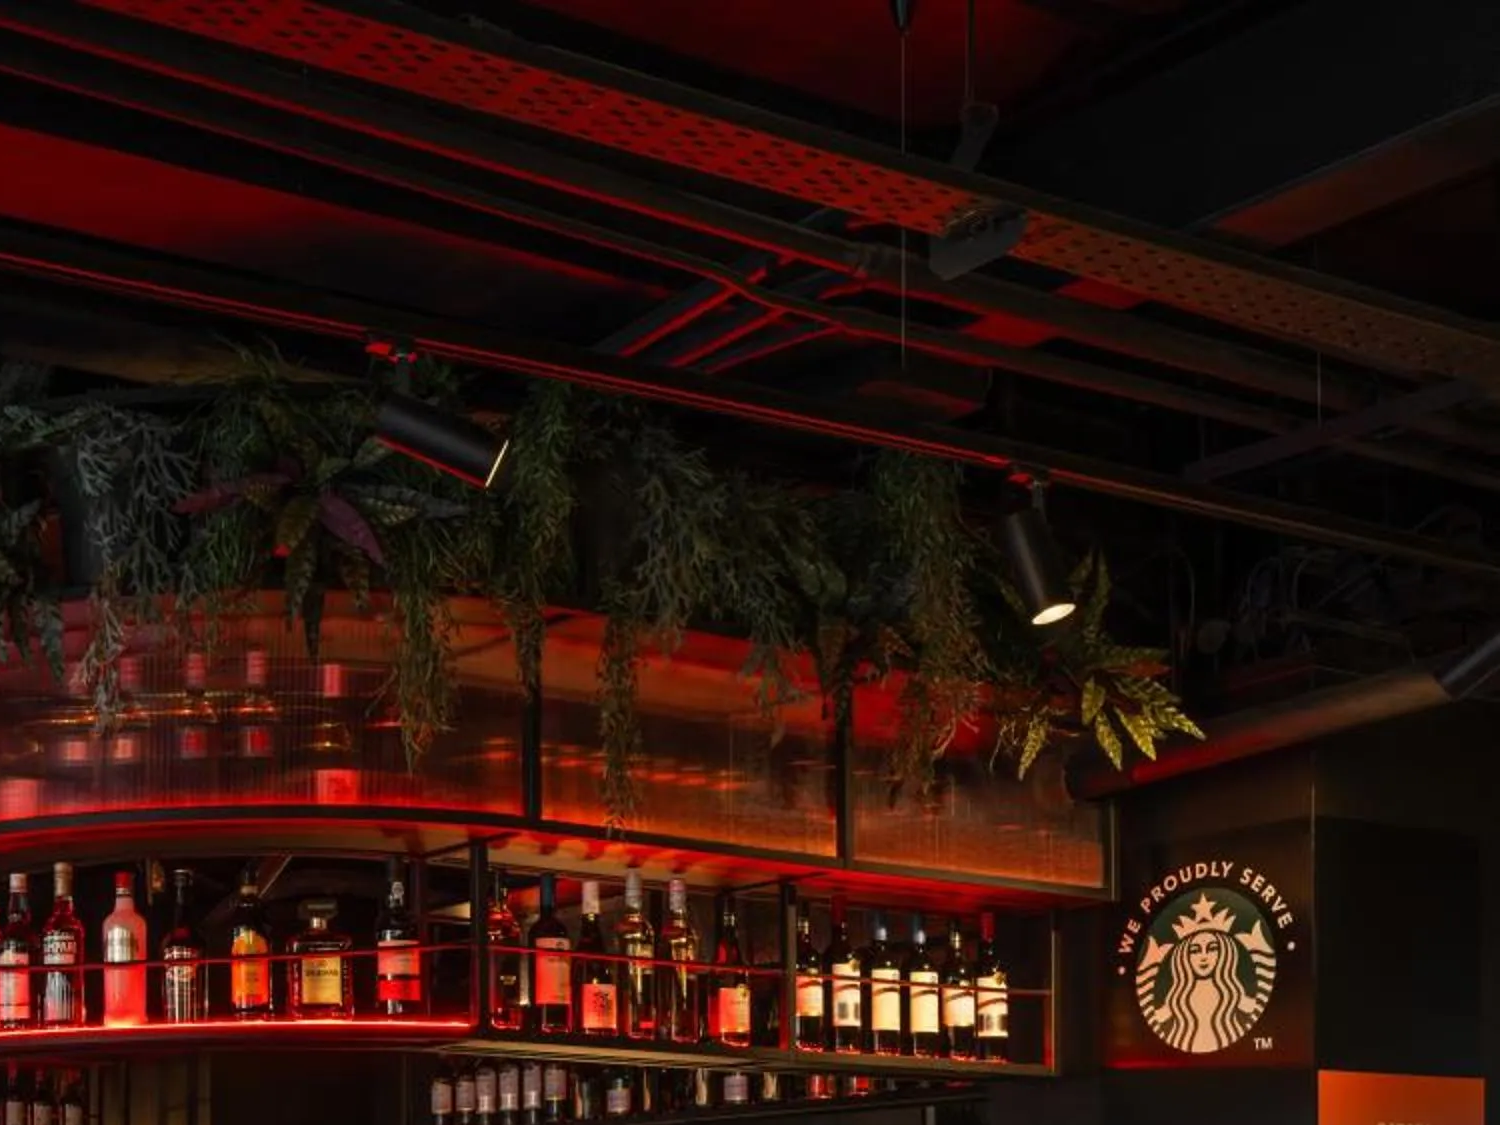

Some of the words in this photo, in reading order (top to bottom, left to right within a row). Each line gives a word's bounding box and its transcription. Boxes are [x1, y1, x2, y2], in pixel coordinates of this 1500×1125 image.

[1118, 919, 1142, 953] WE
[1140, 861, 1234, 913] PROUDLY
[1239, 868, 1293, 929] SERVE
[1253, 1037, 1273, 1050] TM
